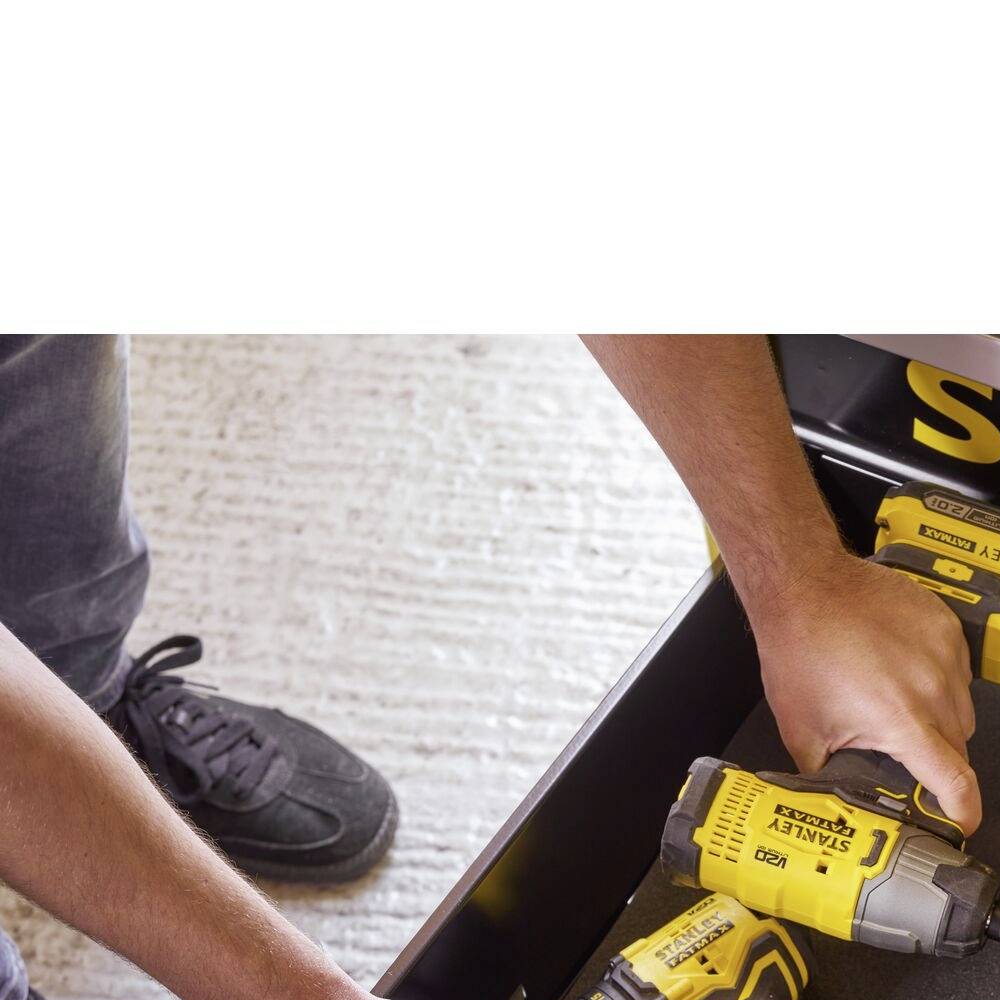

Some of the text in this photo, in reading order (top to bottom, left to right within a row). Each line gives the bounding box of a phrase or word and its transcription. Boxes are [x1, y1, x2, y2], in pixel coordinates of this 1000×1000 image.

[937, 500, 964, 515] 2.0
[923, 527, 973, 551] FATMAX
[767, 817, 852, 853] STANLEY
[780, 806, 853, 836] FATMAX
[754, 849, 788, 869] V20
[655, 910, 725, 961] STANLEY
[669, 922, 730, 967] FATMAX
